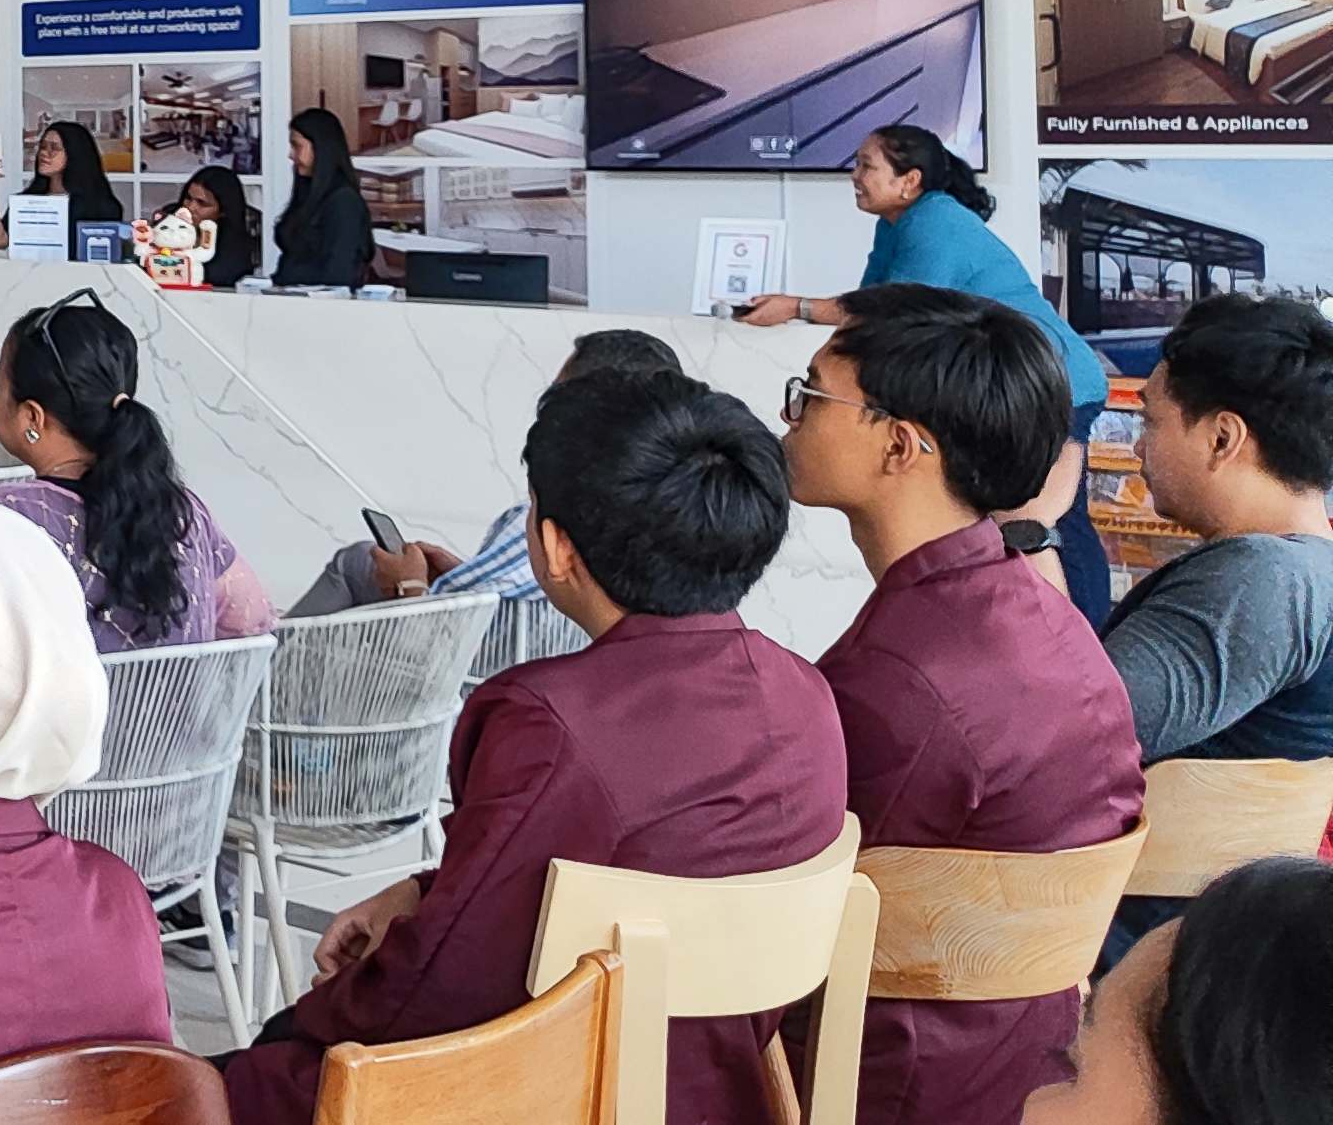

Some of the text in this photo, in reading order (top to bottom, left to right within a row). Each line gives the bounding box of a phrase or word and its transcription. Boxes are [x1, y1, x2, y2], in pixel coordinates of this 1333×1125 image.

[36, 14, 82, 25] Experience
[92, 9, 146, 21] comfortable
[148, 9, 165, 19] and
[167, 8, 216, 20] productive
[219, 6, 242, 16] work
[38, 28, 62, 39] place
[63, 26, 81, 36] with
[91, 25, 108, 35] free
[110, 24, 128, 34] trial
[129, 25, 138, 33] at
[140, 25, 155, 33] our
[157, 23, 205, 34] coworking
[1047, 115, 1309, 133] Fully Furnished & Appliances
